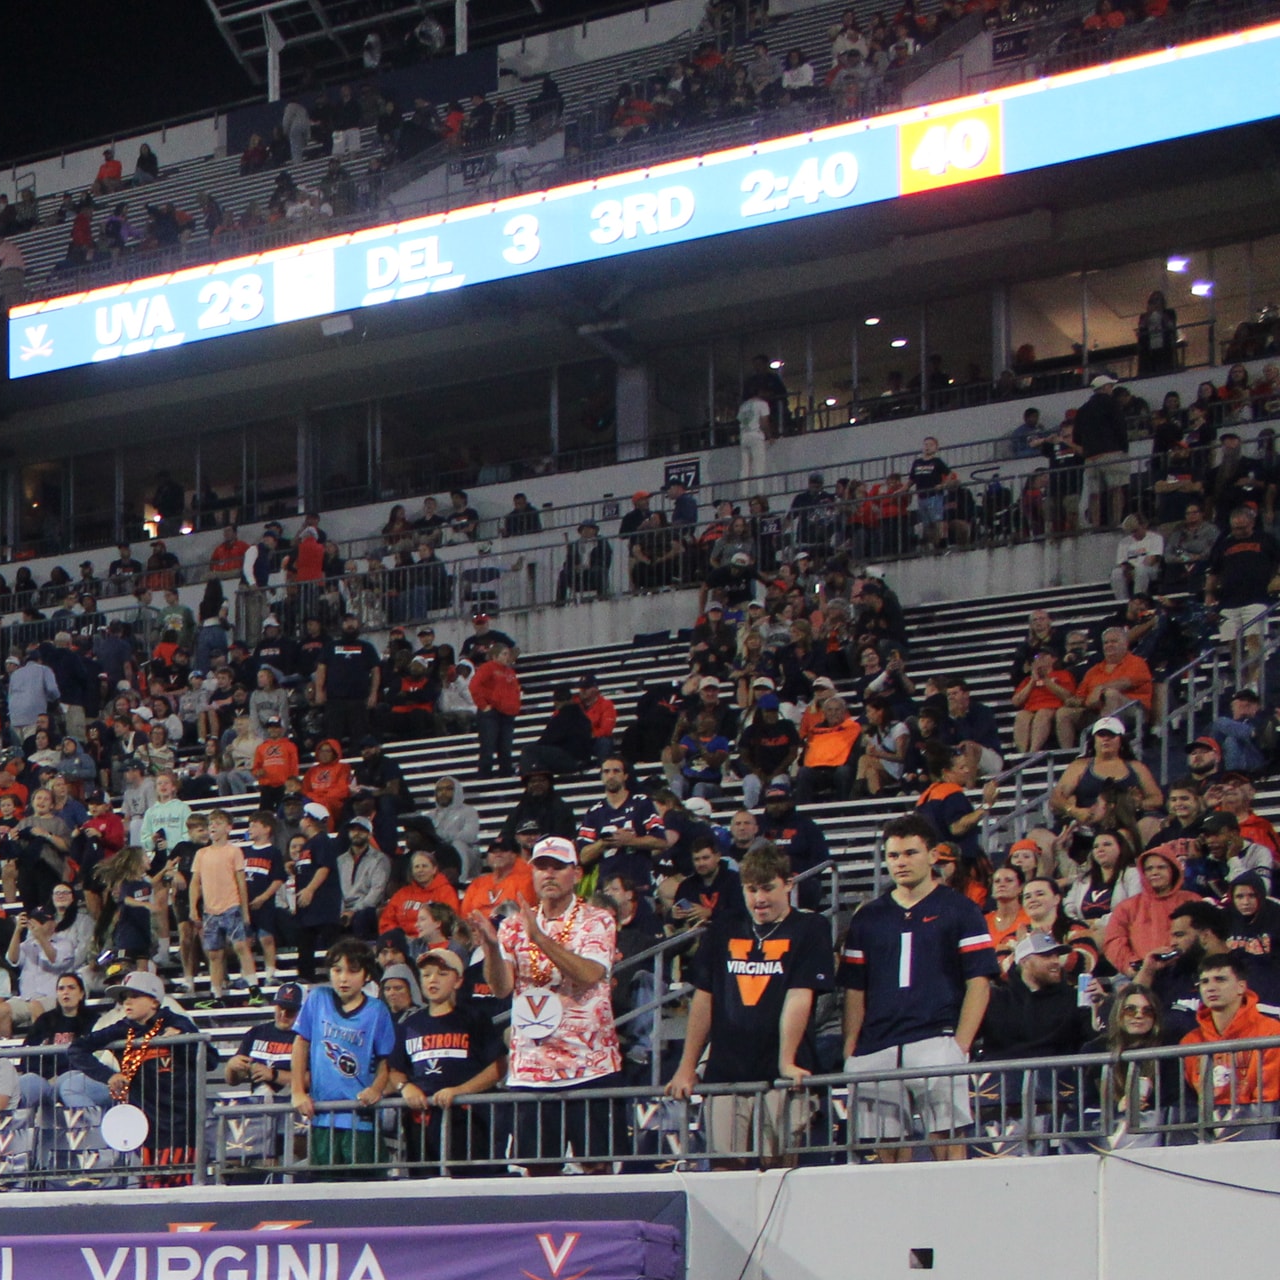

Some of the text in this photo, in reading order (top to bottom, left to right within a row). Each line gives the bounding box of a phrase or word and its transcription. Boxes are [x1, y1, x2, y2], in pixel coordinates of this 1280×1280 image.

[96, 295, 175, 345] UVA
[197, 274, 265, 330] 28
[366, 236, 454, 290] DEL
[502, 213, 540, 264] 3
[590, 187, 696, 244] 3RD
[740, 152, 860, 217] 2:40
[910, 117, 991, 176] 40
[727, 961, 784, 975] VIRGINIA
[899, 931, 913, 988] 1
[405, 1033, 470, 1056] UVASTRONG
